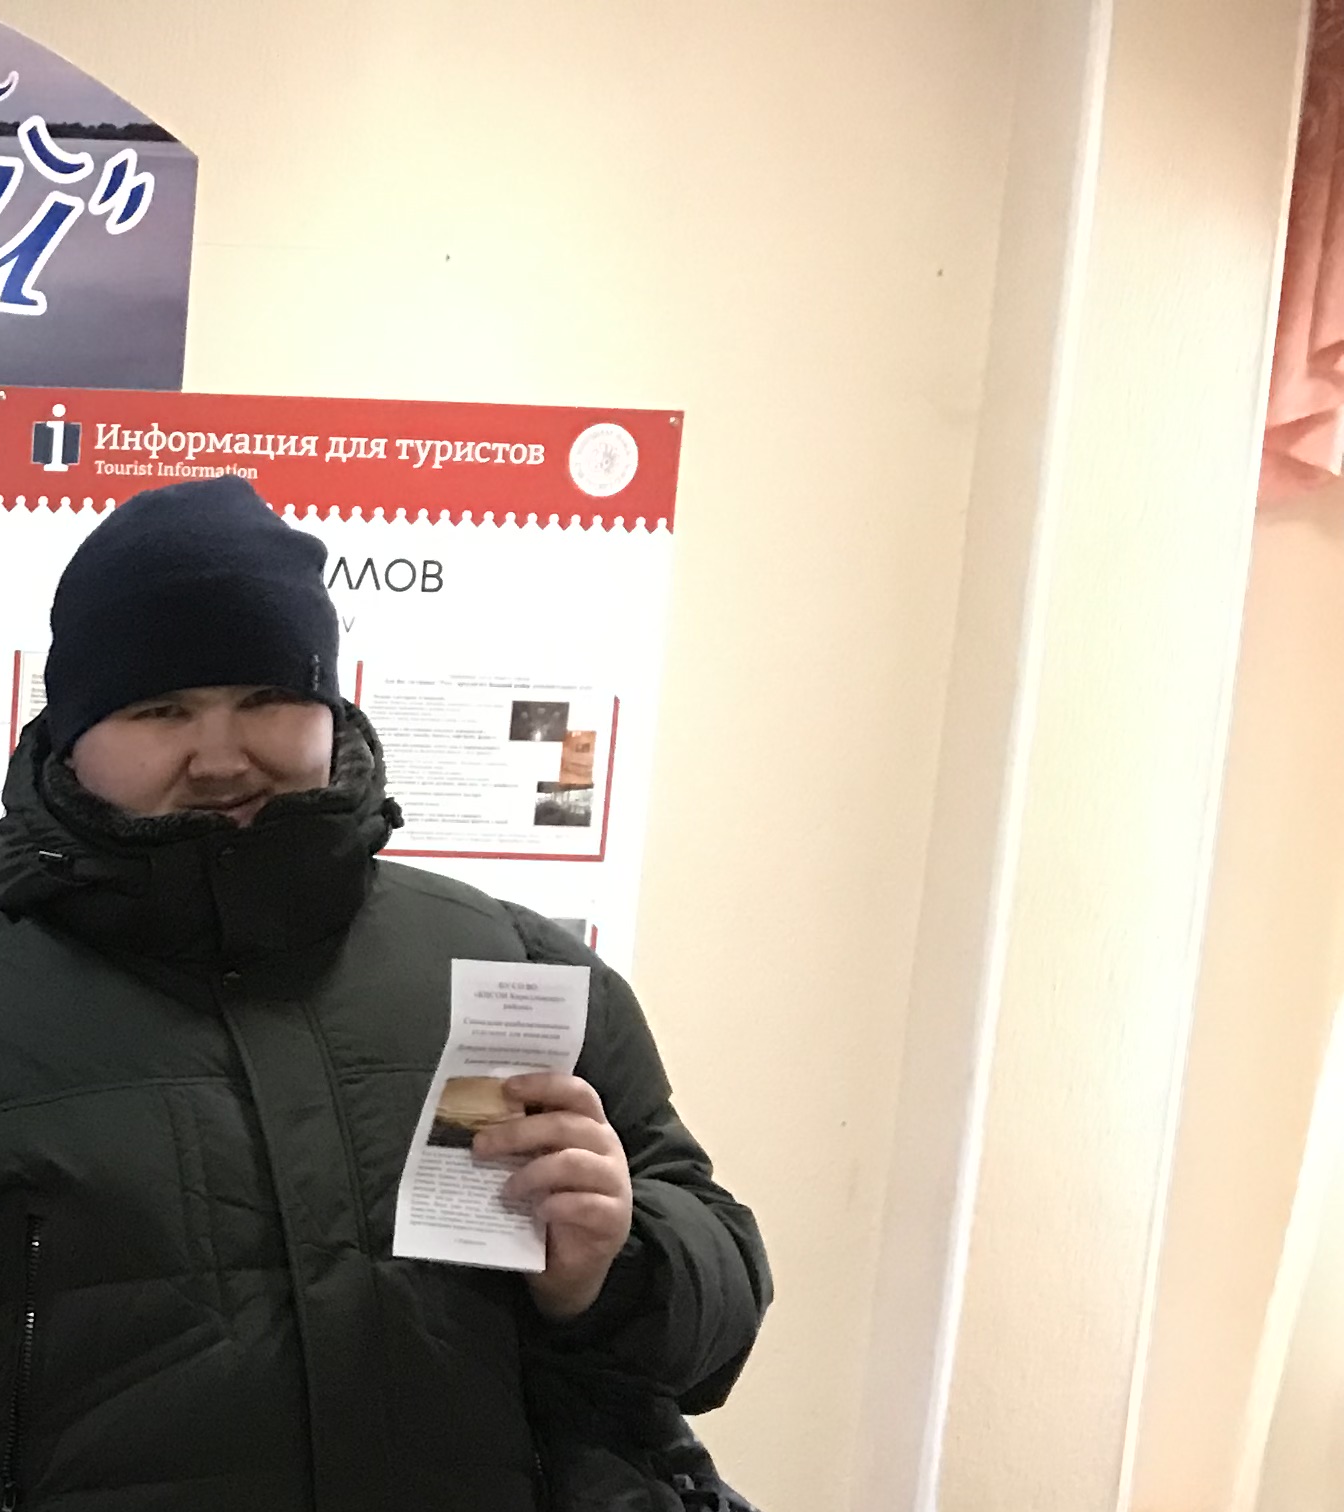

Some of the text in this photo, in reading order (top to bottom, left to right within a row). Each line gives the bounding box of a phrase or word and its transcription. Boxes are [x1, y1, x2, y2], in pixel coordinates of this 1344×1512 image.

[94, 423, 317, 461] Информация
[325, 433, 387, 463] для
[396, 438, 546, 469] туристов
[94, 460, 258, 480] Tourist Information
